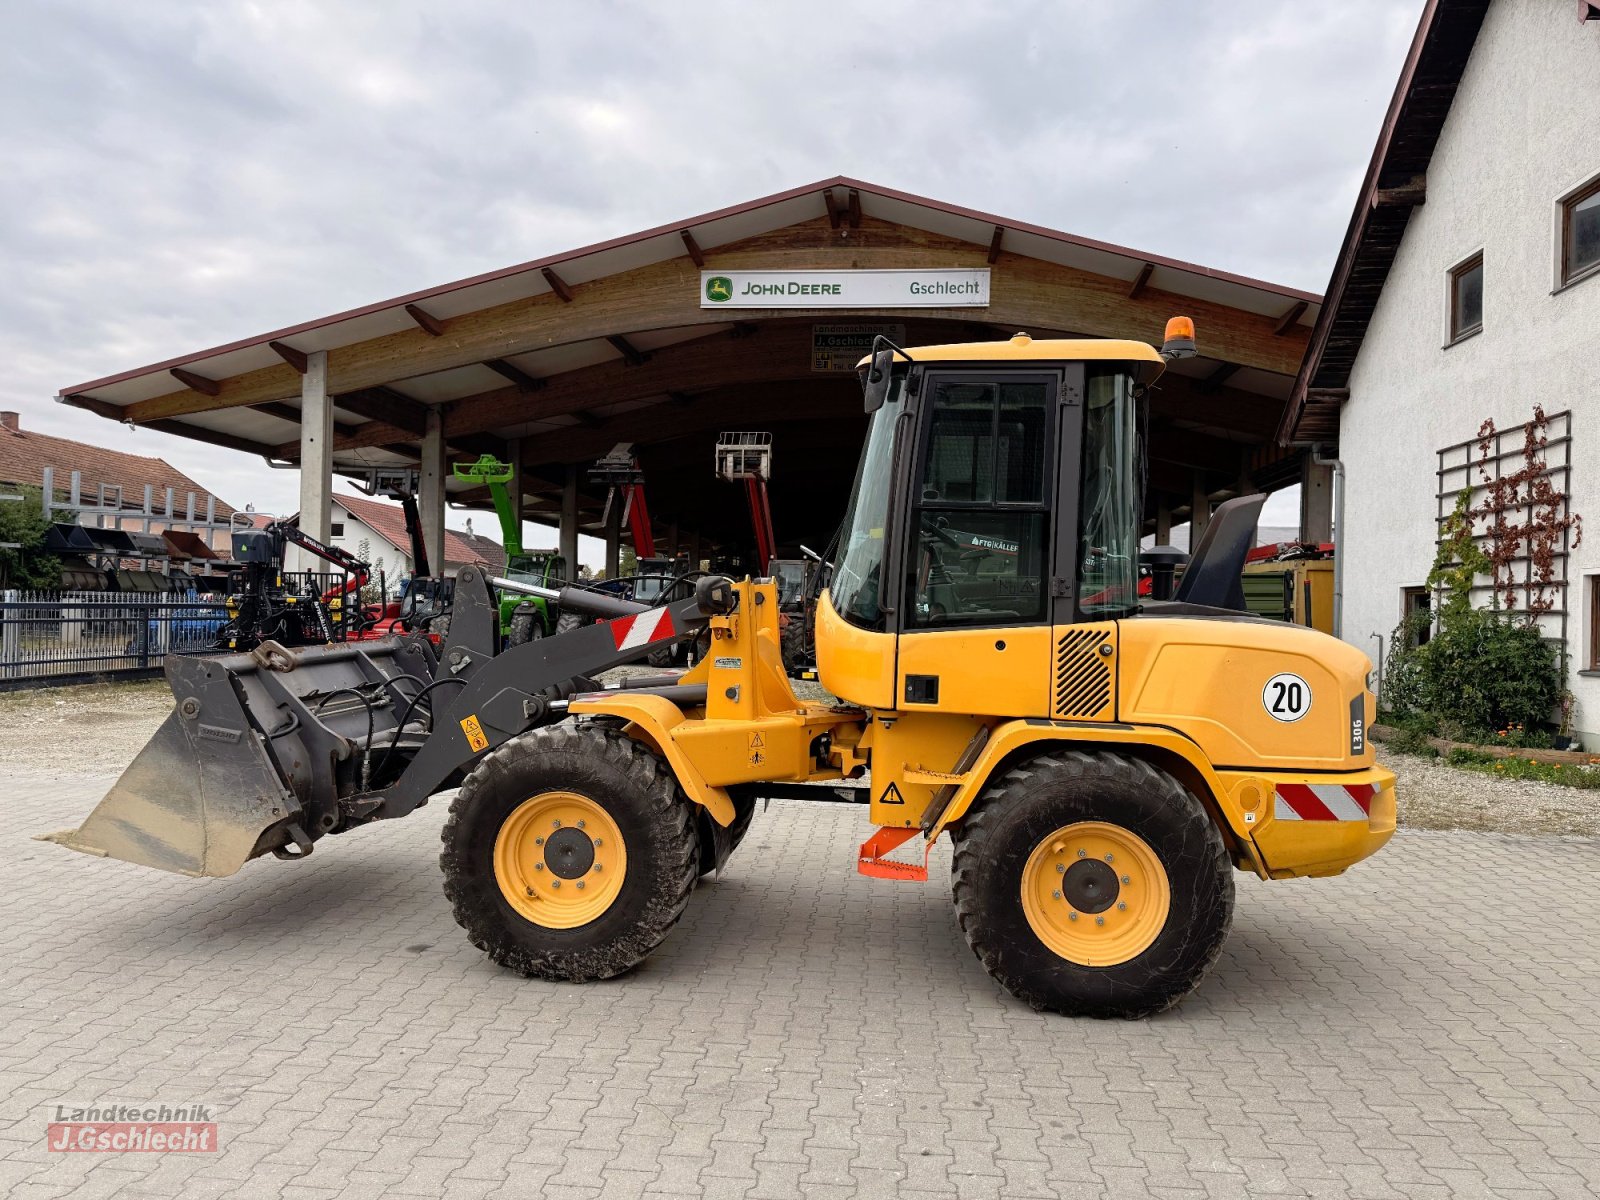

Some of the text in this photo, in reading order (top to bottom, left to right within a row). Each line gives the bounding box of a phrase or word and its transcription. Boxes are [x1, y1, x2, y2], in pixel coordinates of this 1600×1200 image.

[741, 281, 842, 295] JOHN DEERE
[909, 280, 980, 295] Gschlecht
[827, 336, 875, 346] Gschlec
[1272, 682, 1302, 713] 20
[1353, 719, 1362, 750] L30G
